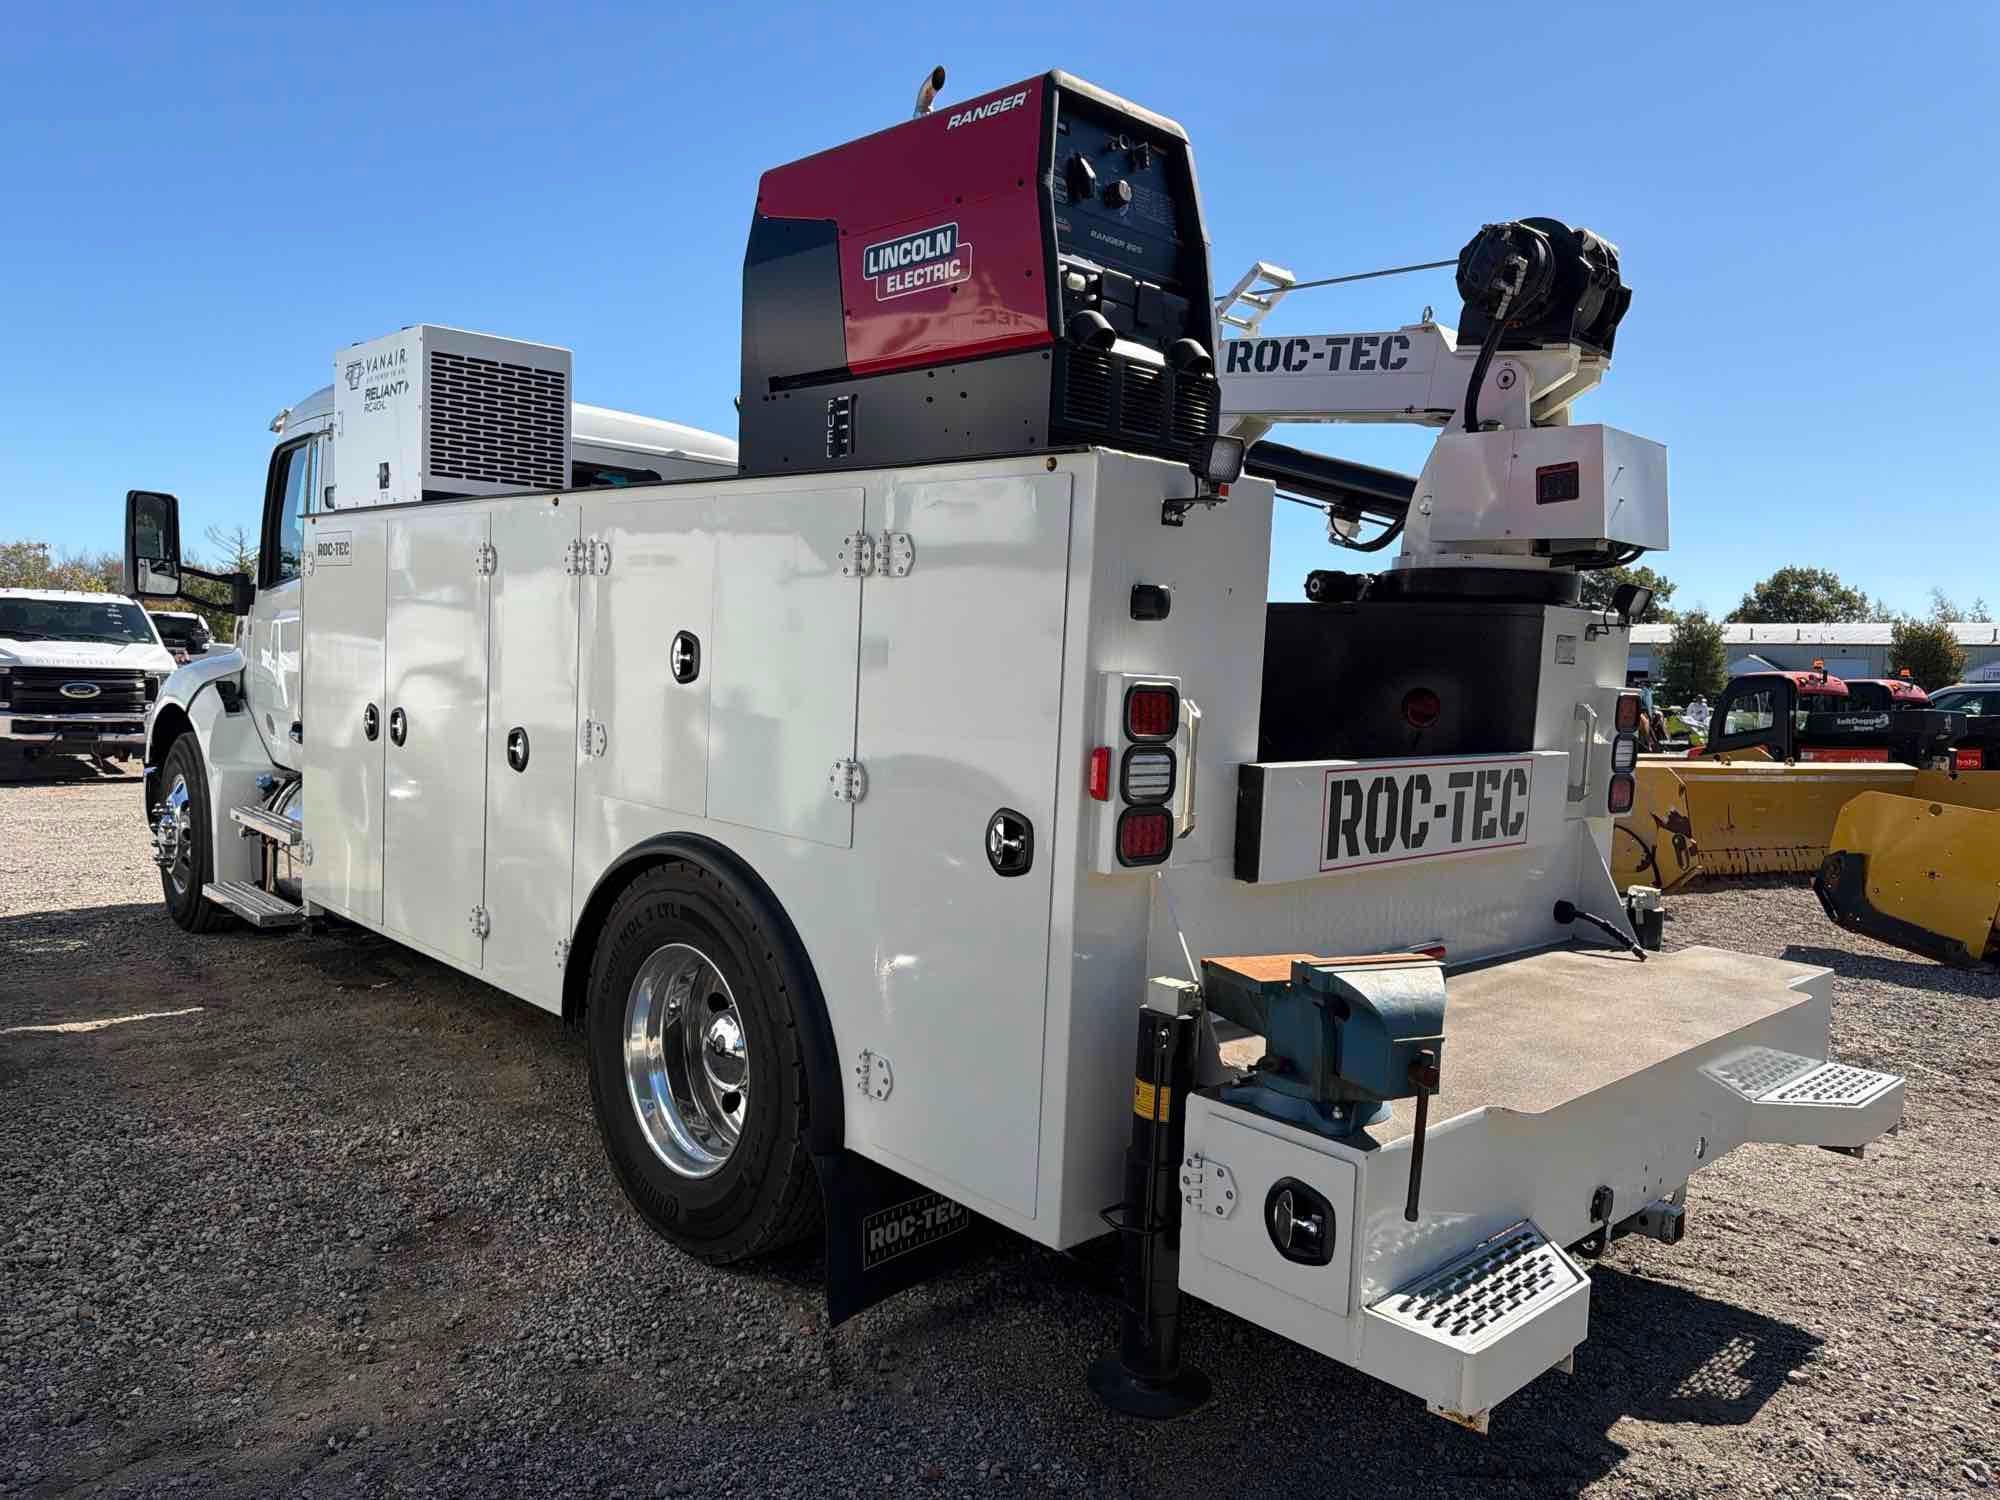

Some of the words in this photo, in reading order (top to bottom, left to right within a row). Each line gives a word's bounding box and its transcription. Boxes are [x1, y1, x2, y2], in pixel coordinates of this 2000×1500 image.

[947, 91, 1028, 130] RANGER
[867, 229, 952, 274] LINCOLN
[885, 259, 962, 295] ELECTRIC
[366, 348, 406, 374] VANAIR
[1226, 334, 1411, 374] ROC-TEC
[364, 380, 404, 402] RELIANT
[826, 399, 835, 459] FUEL
[317, 541, 350, 556] ROC-TEC
[1326, 767, 1529, 860] ROC-TEC
